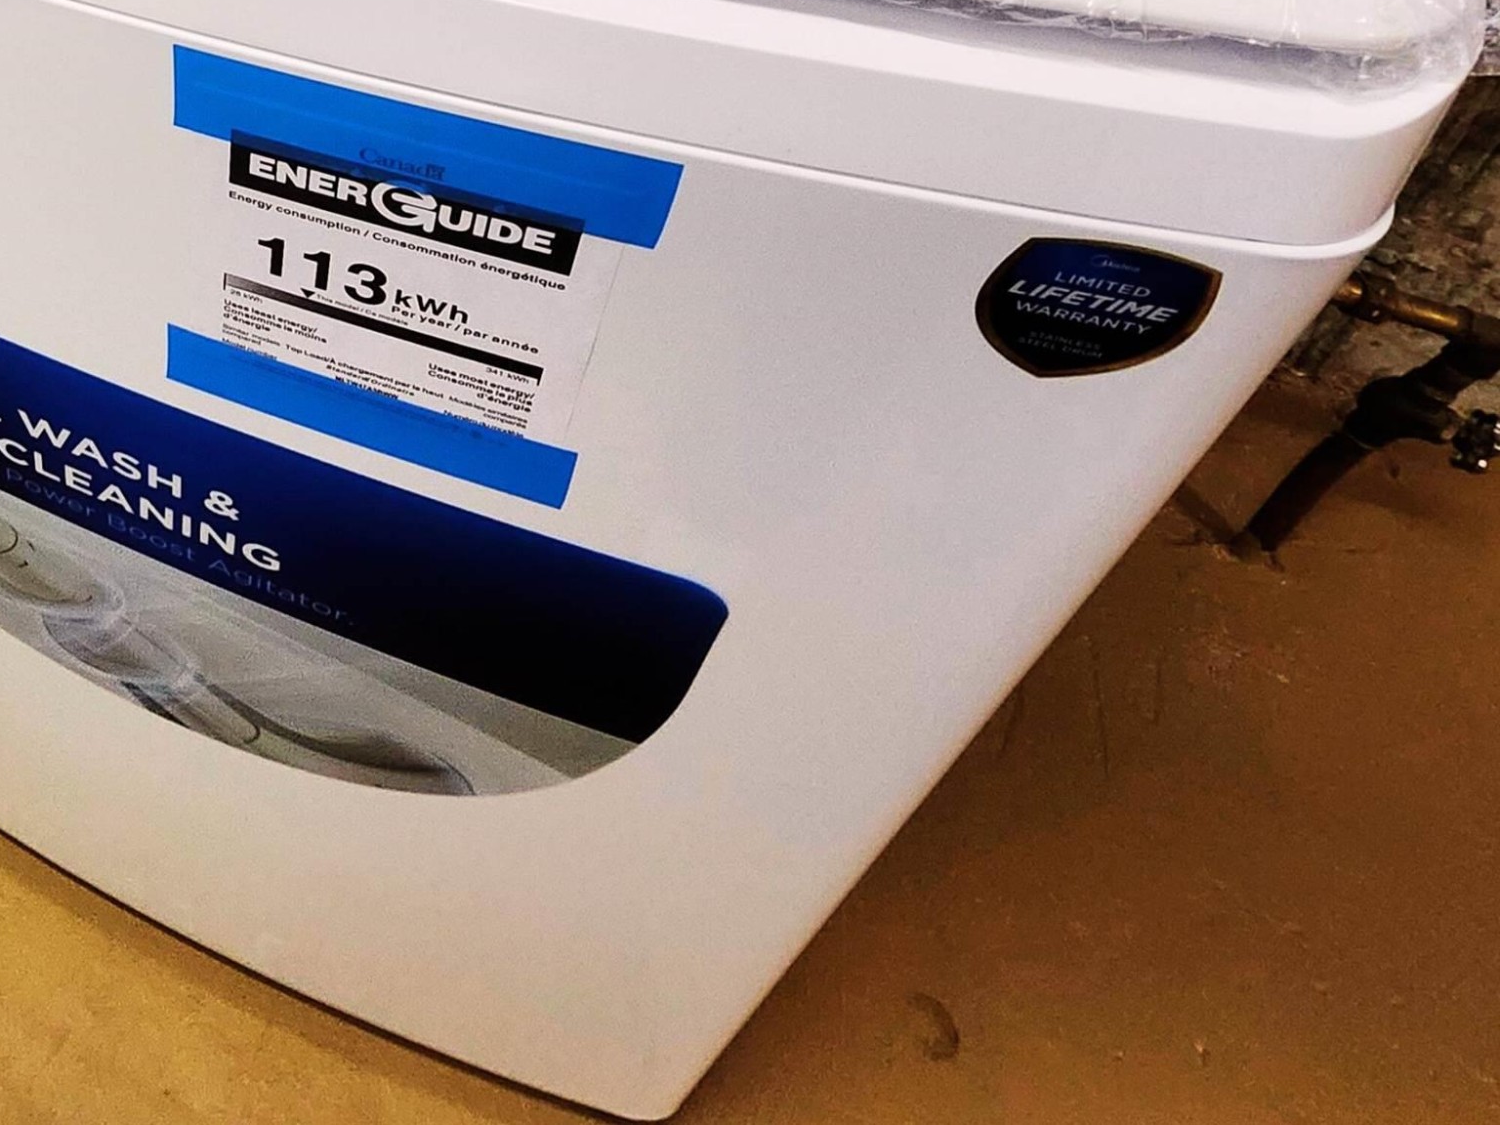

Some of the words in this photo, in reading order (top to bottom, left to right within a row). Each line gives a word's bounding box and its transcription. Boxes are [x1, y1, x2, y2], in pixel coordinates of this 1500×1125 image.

[249, 152, 557, 255] ENERGUIDE
[228, 190, 274, 211] Energy
[275, 205, 362, 237] consumption
[372, 231, 477, 269] Consommation
[479, 260, 567, 291] énergétique
[257, 237, 388, 306] 113
[394, 289, 470, 324] kWh
[1008, 279, 1179, 324] LIFETIME
[1054, 270, 1152, 299] LIMITED
[223, 305, 283, 329] Consomme
[294, 328, 328, 344] moins
[224, 298, 250, 312] Uses
[251, 307, 277, 320] least
[391, 305, 417, 319] Per
[419, 314, 453, 329] year
[463, 326, 490, 339] par
[492, 335, 540, 355] année
[1016, 299, 1153, 335] WARRANTY
[285, 343, 303, 355] Top
[421, 387, 445, 400] haut
[428, 362, 458, 377] Uses
[458, 370, 489, 387] most
[489, 379, 536, 400] energy/
[428, 369, 494, 398] Consomme
[506, 391, 533, 407] plus
[507, 372, 530, 385] kWh
[17, 407, 183, 500] WASH
[203, 489, 241, 522] &
[5, 463, 97, 518] Power
[107, 513, 197, 563] Boost
